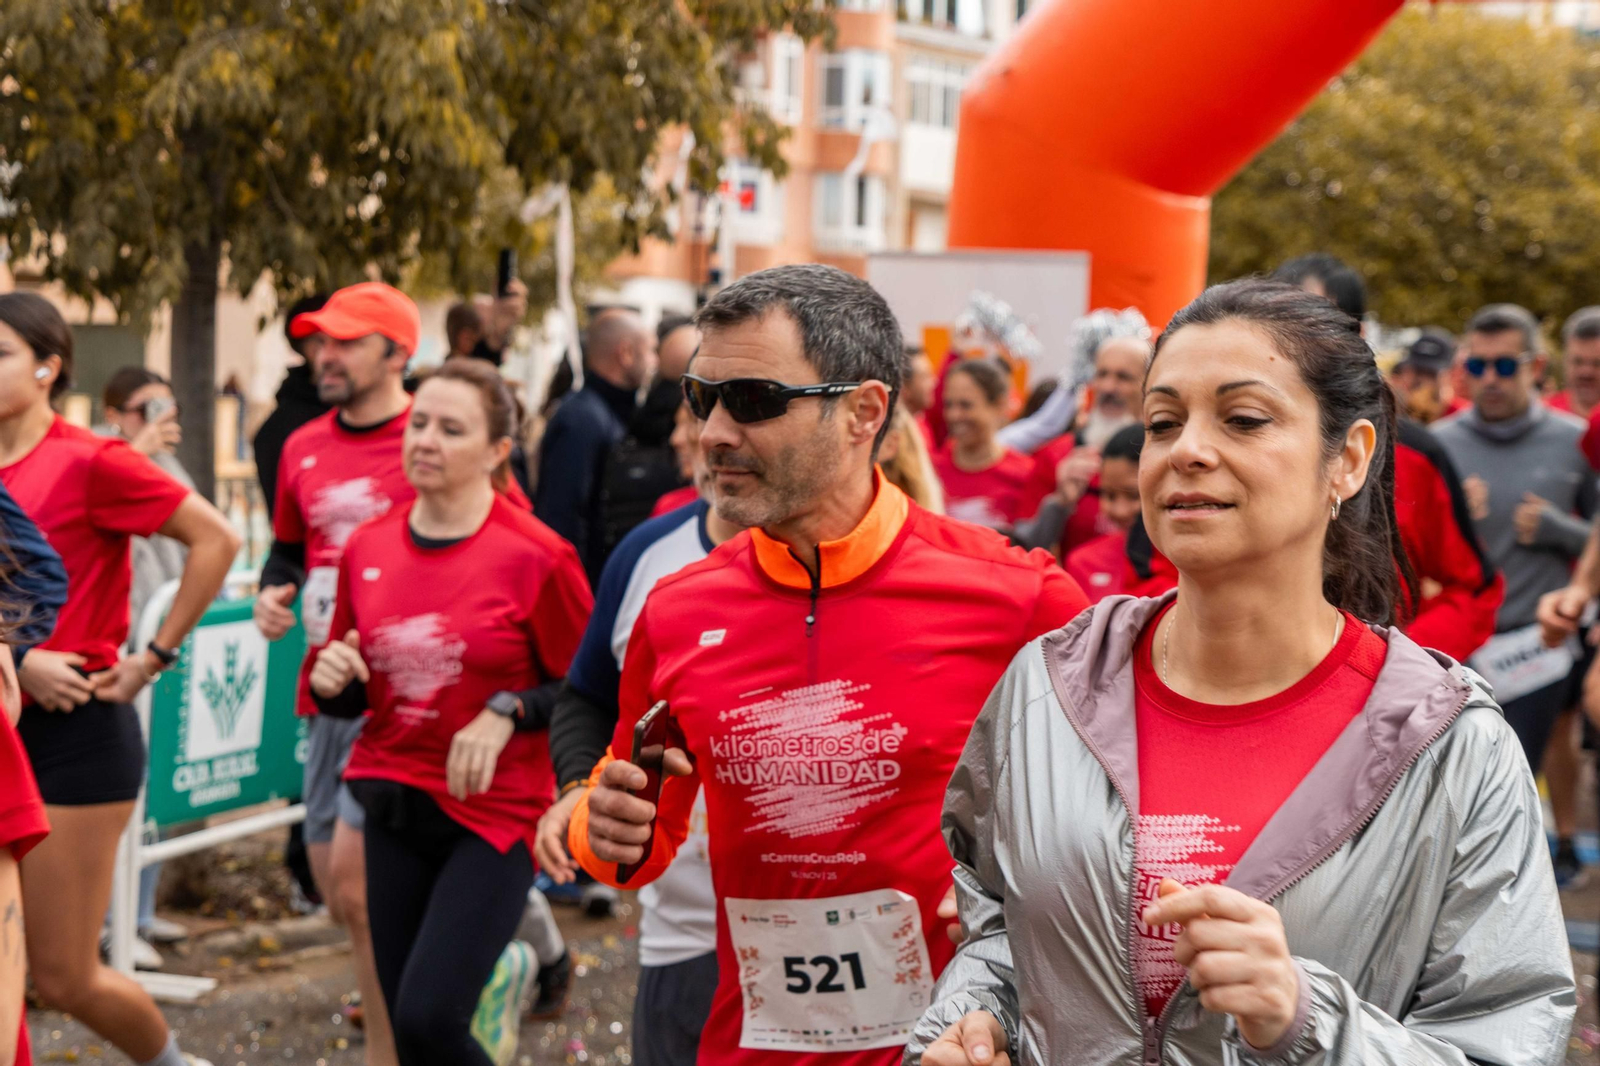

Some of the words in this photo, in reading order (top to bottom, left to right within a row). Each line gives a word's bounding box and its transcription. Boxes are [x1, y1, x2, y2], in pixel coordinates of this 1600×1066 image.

[709, 733, 854, 758] kilómetros
[861, 730, 900, 754] de
[717, 760, 901, 785] HUMANIDAD
[785, 952, 866, 994] 521
